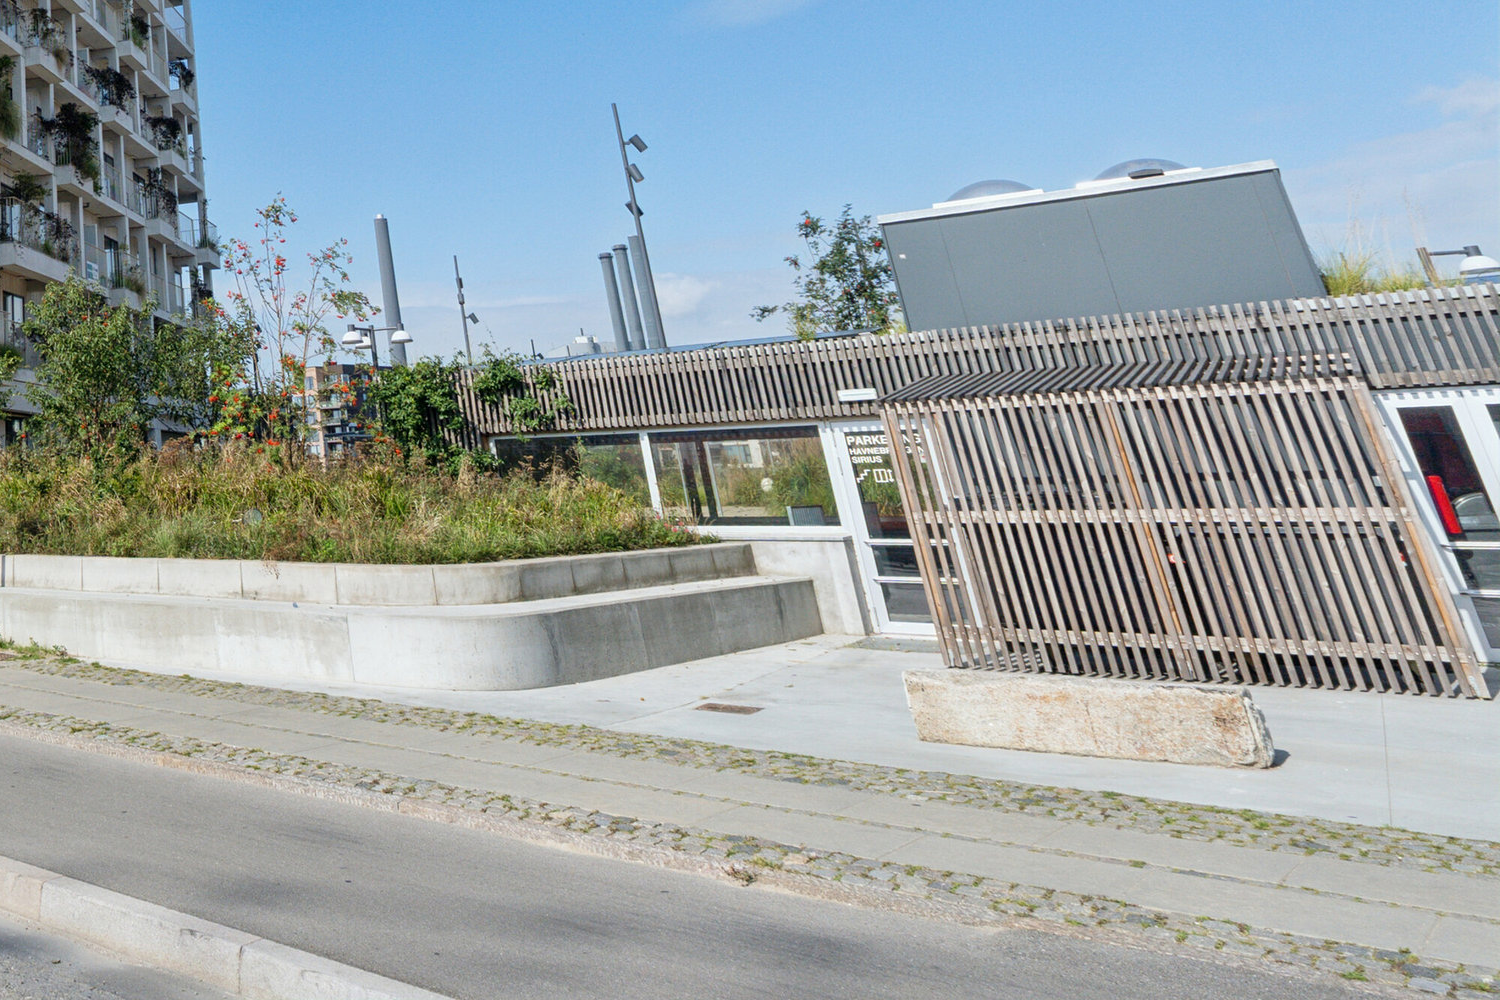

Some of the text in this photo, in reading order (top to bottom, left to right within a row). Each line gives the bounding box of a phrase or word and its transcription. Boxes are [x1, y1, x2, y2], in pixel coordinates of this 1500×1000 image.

[846, 433, 921, 446] PARKENG
[848, 446, 924, 456] HAVNEBGN
[851, 455, 883, 464] SIRIUS
